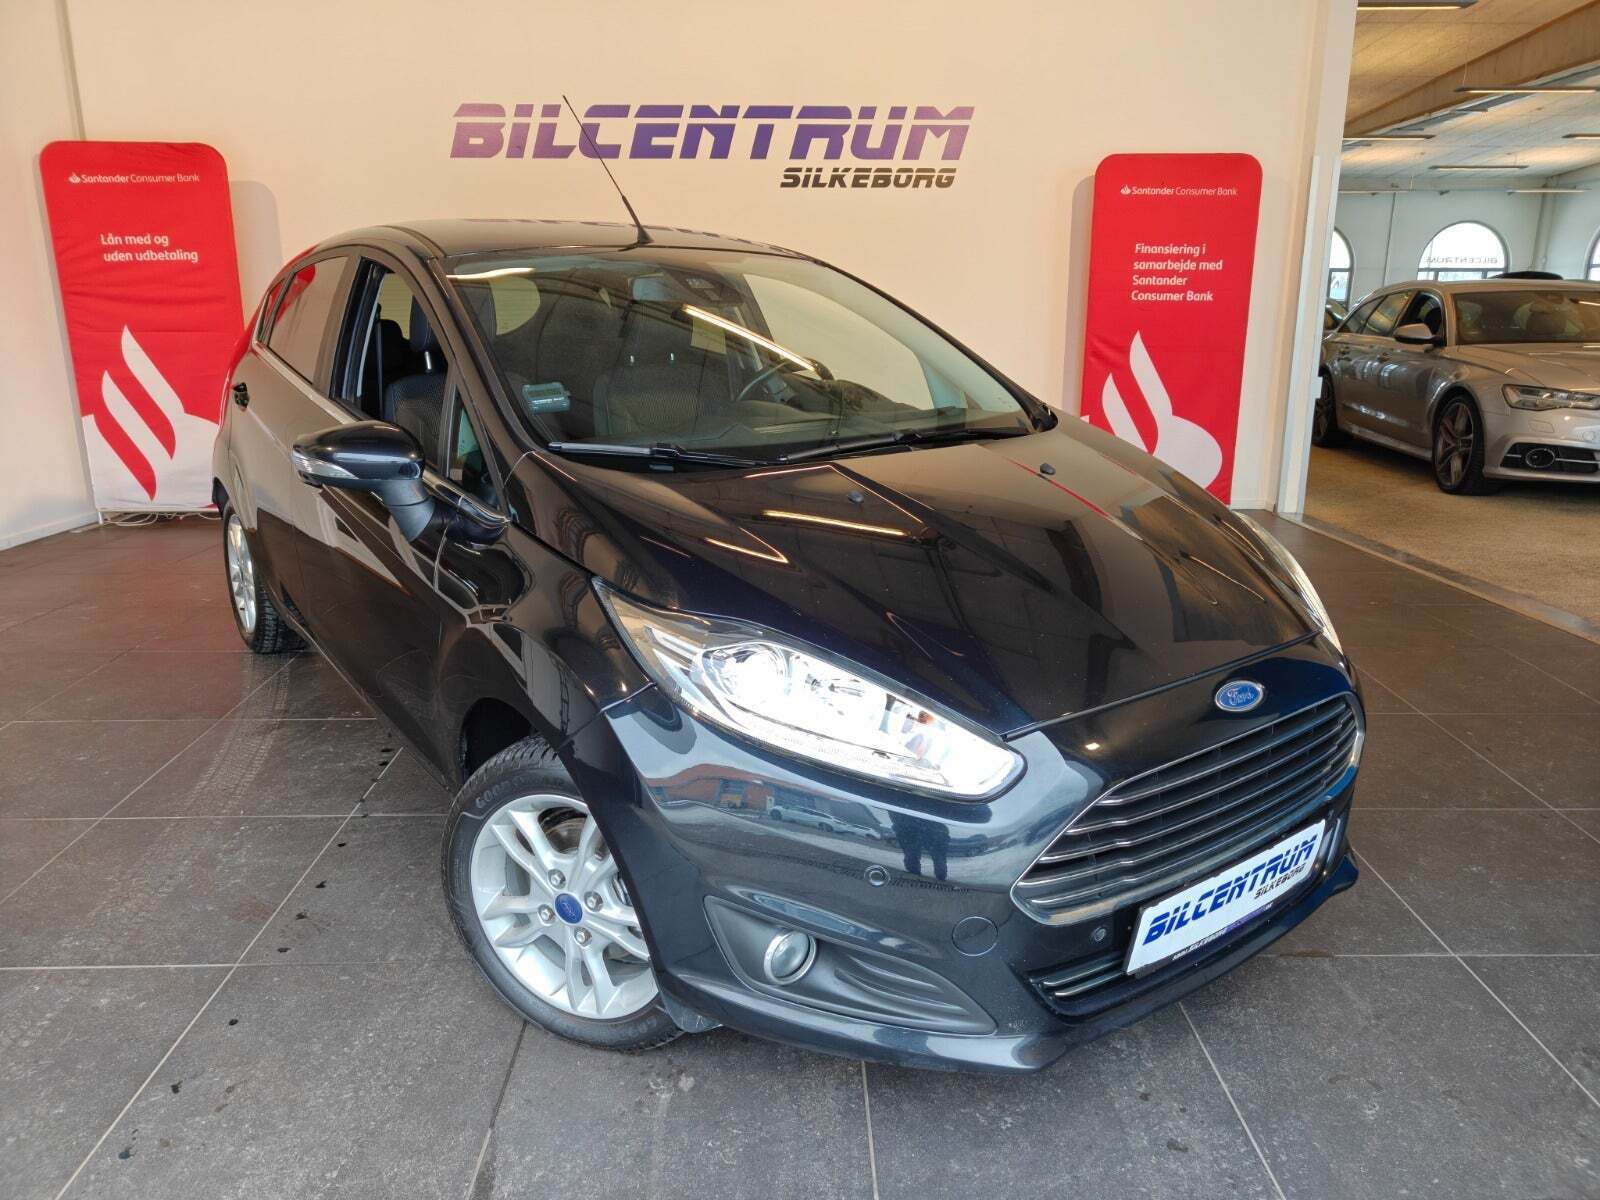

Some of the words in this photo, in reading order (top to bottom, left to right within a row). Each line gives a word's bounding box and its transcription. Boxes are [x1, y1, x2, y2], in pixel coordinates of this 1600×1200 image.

[450, 103, 975, 161] BILCENTRUM
[81, 173, 129, 183] Santander
[130, 173, 176, 183] Consumer
[177, 173, 200, 182] Bank
[780, 167, 957, 189] SILKEBORG
[1131, 186, 1174, 196] Santander
[1175, 187, 1217, 196] Consumer
[1217, 187, 1238, 195] Bank
[100, 233, 122, 245] Lån
[125, 234, 151, 245] med
[153, 236, 169, 247] og
[103, 250, 132, 262] uden
[135, 249, 198, 263] udbetaling
[1135, 243, 1200, 257] Finansiering
[1202, 243, 1206, 254] i
[1133, 259, 1196, 273] samarbejde
[1199, 260, 1223, 270] med
[1132, 274, 1188, 286] Santander
[1131, 290, 1184, 301] Consumer
[1186, 290, 1213, 301] Bank
[1254, 863, 1307, 900] SILKEBORG
[1142, 834, 1318, 946] BILCENTRUM
